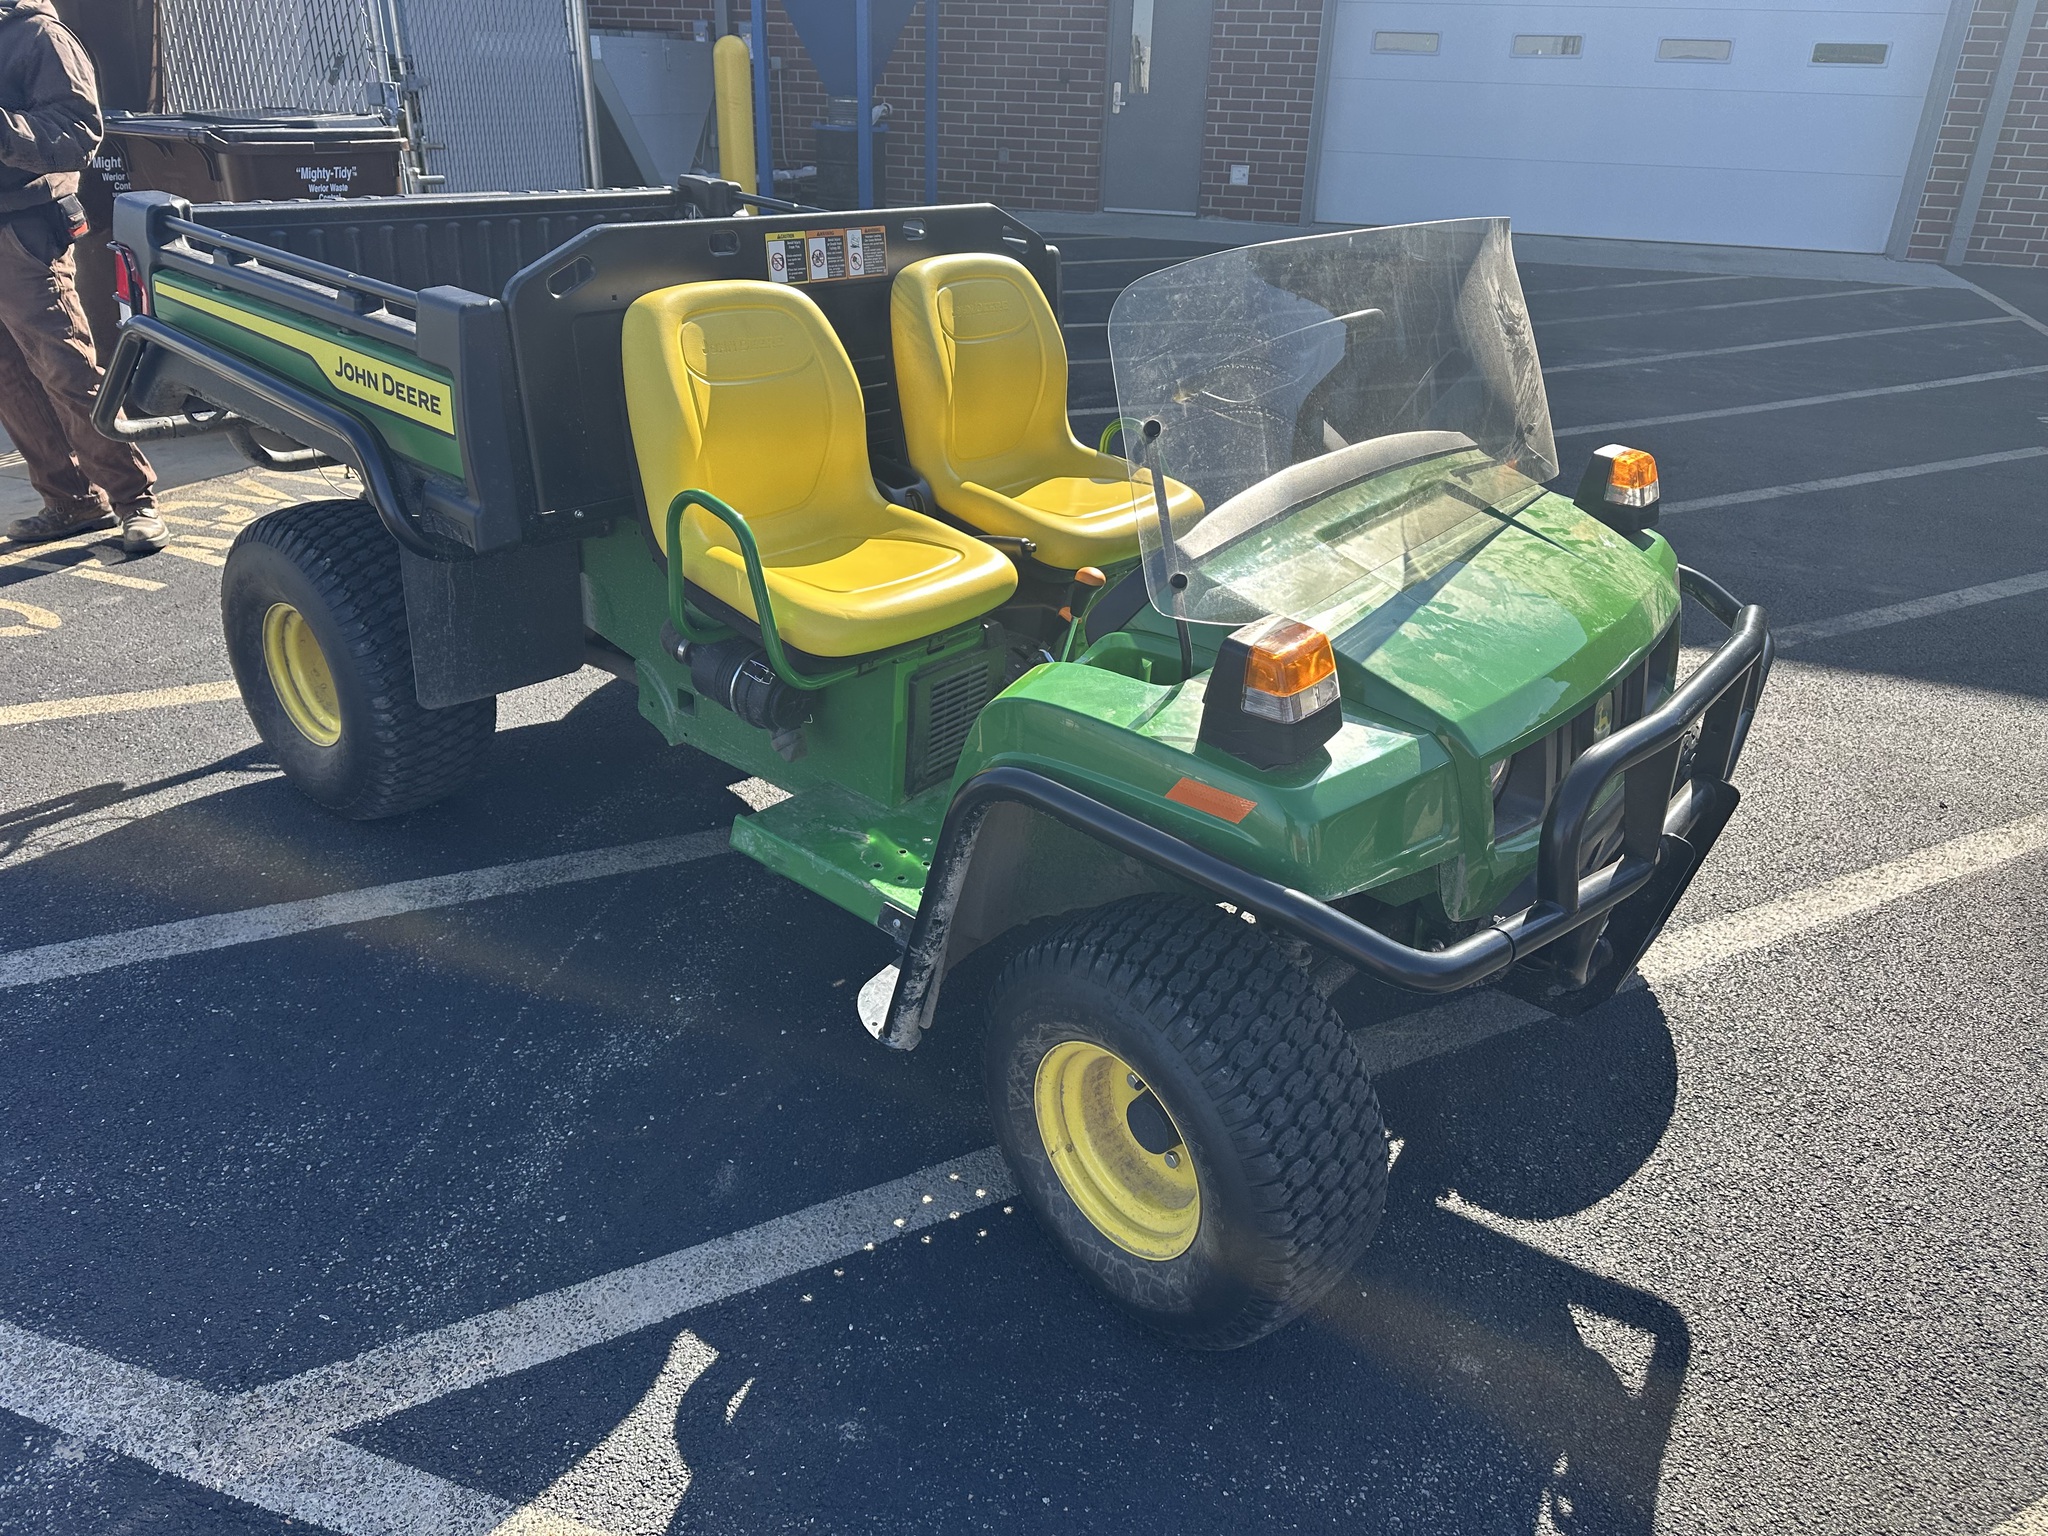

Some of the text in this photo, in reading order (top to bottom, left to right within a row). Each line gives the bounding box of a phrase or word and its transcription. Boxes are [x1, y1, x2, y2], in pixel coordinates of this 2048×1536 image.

[329, 183, 348, 192] Waste
[335, 356, 441, 416] JOHN DEERE
